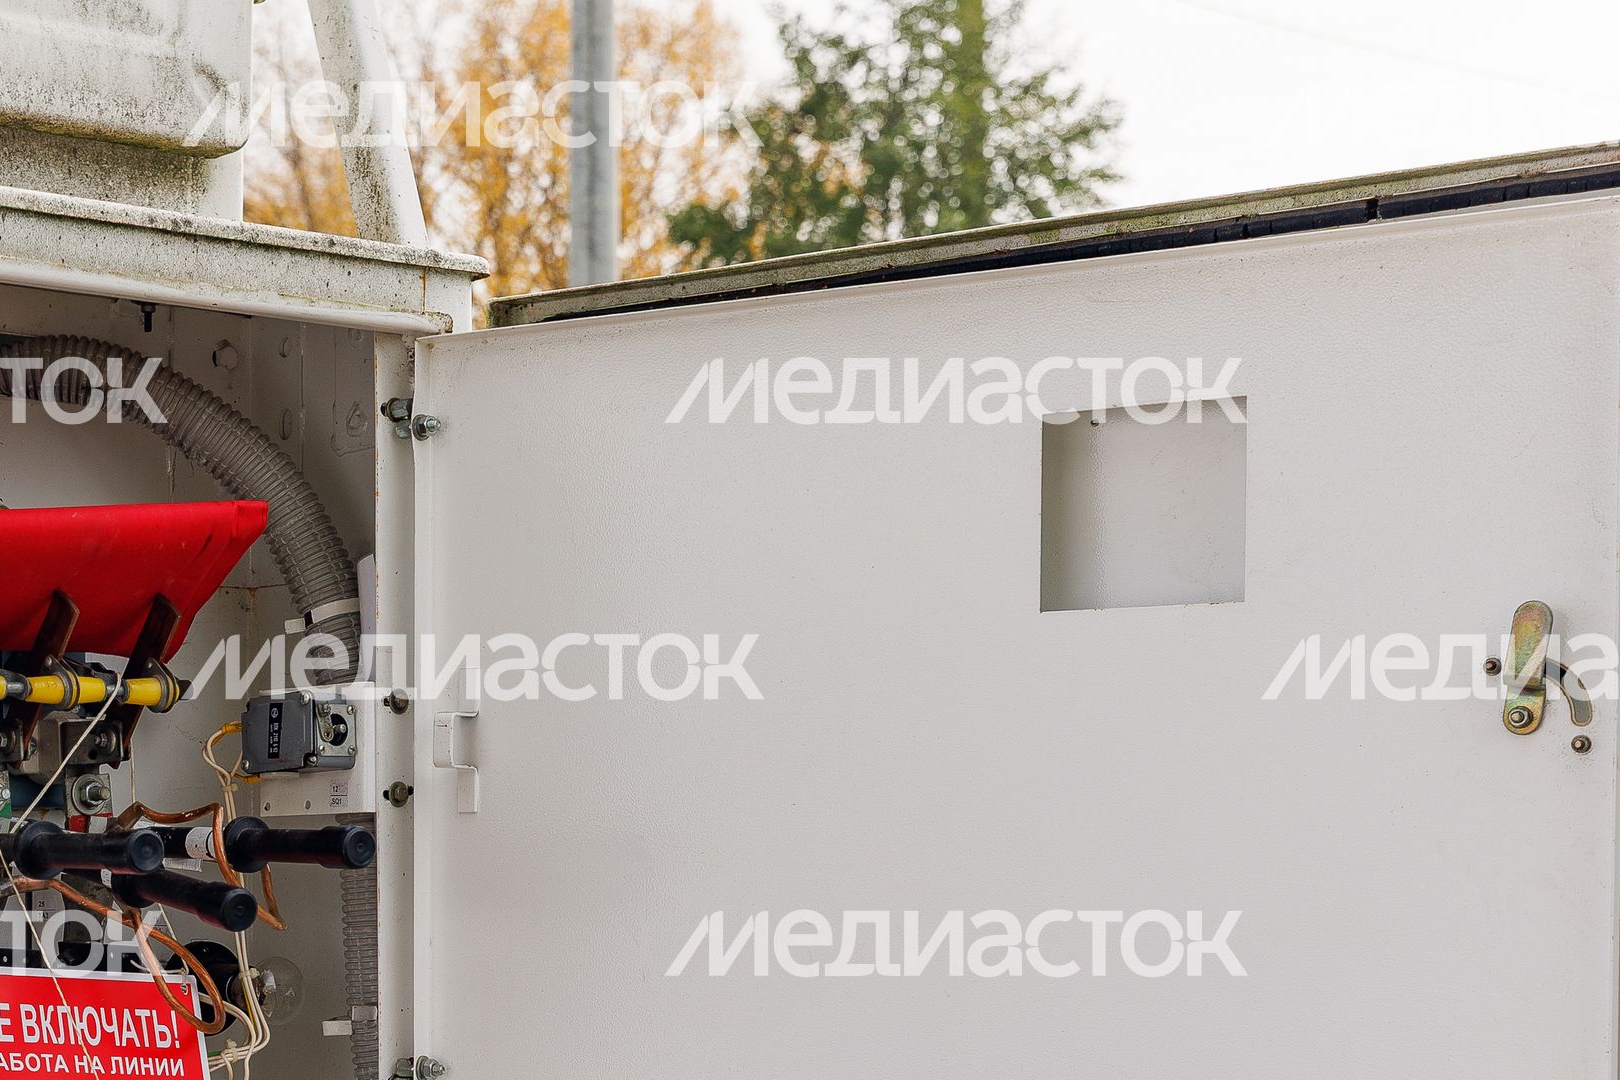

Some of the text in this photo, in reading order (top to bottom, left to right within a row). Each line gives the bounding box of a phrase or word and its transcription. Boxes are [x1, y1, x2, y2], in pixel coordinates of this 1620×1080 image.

[331, 797, 342, 805] SQ1
[18, 1003, 181, 1049] ВКЛЮЧАТЬ!
[72, 1053, 105, 1076] НА
[110, 1055, 185, 1078] ЛИНИИ
